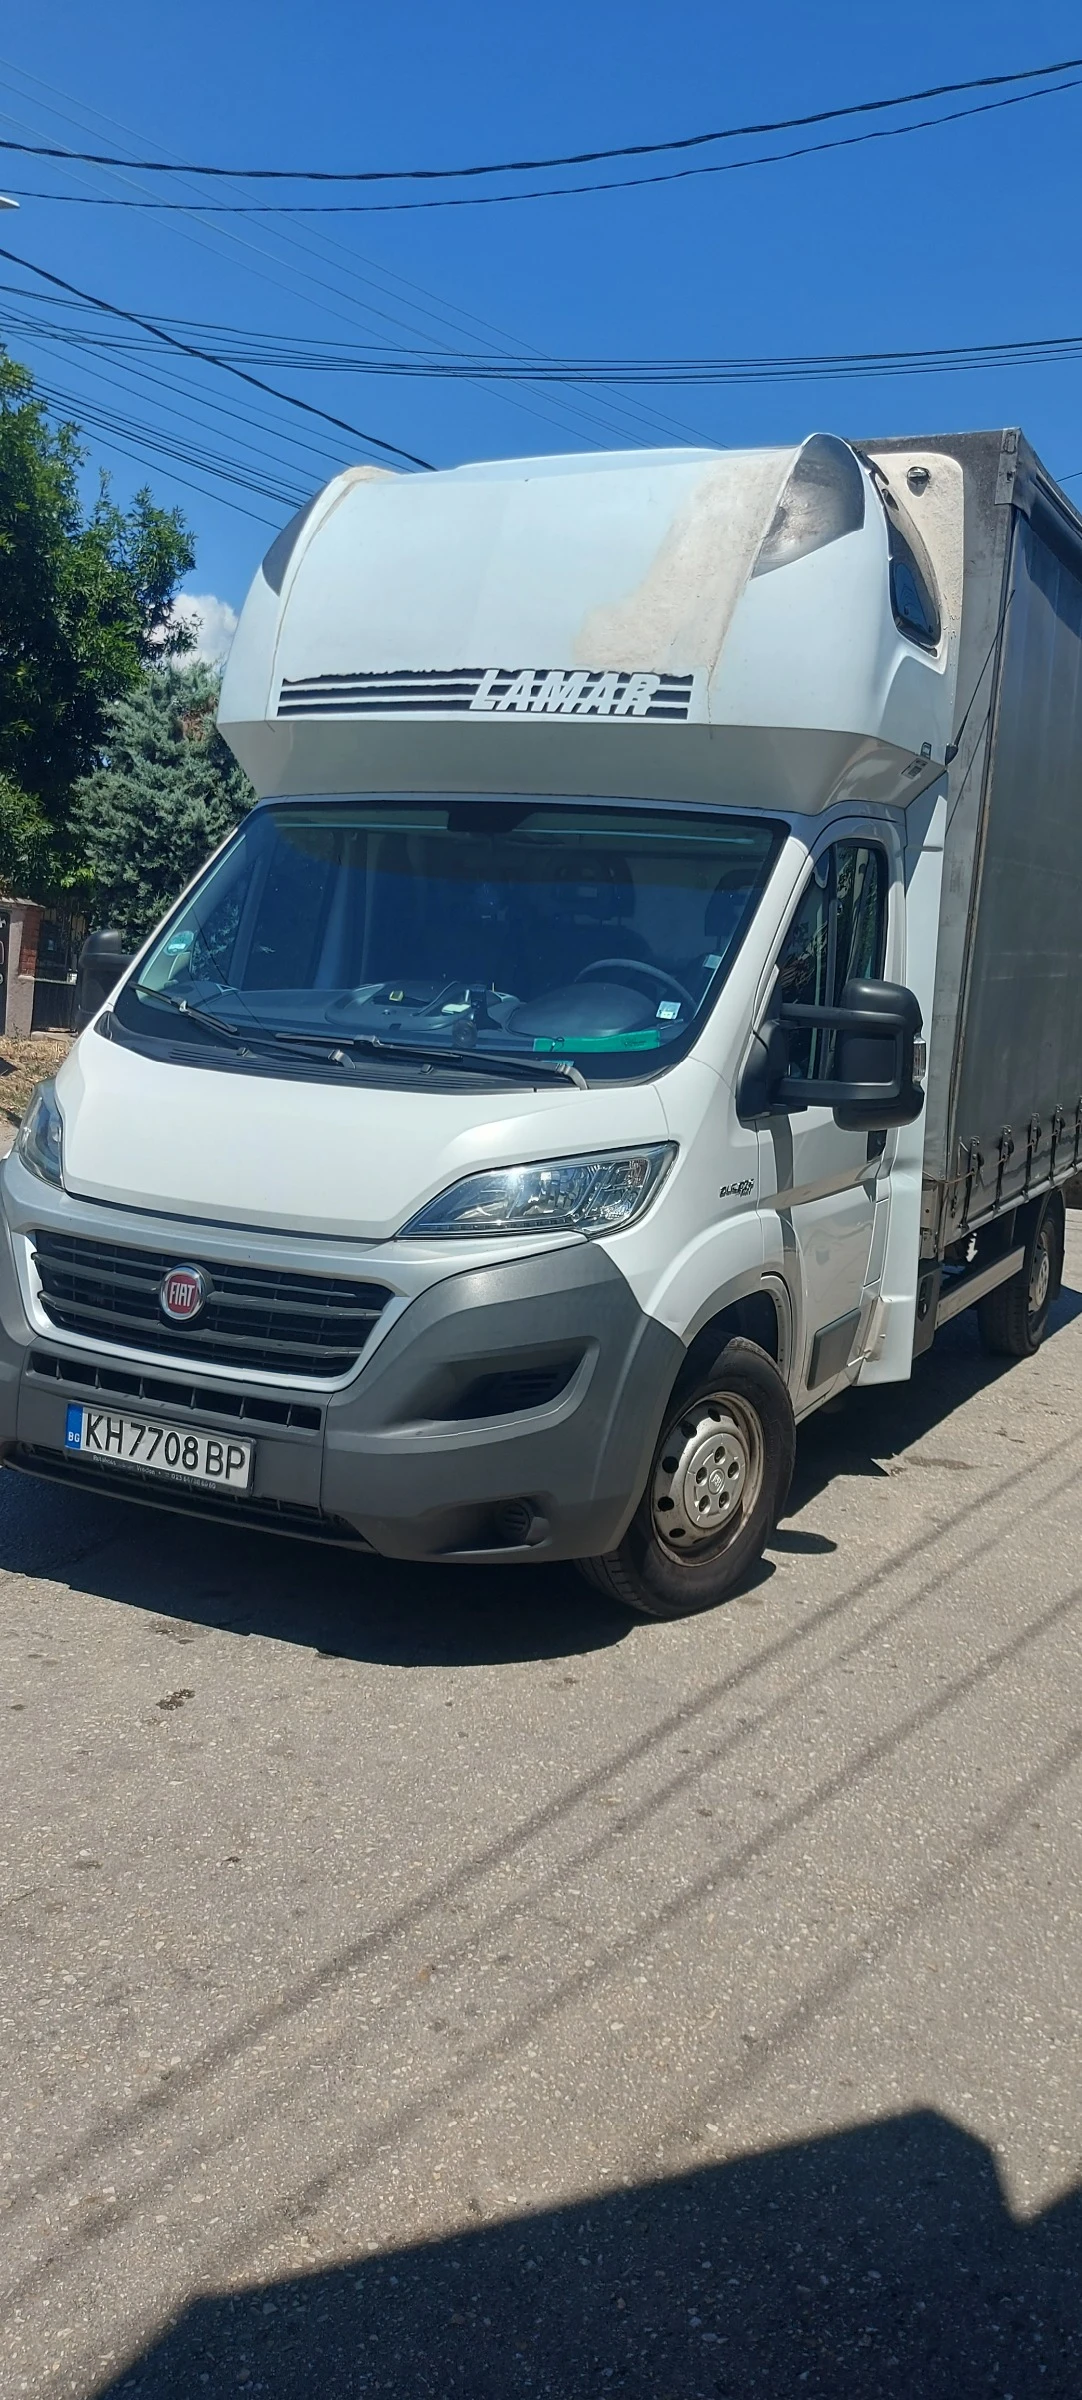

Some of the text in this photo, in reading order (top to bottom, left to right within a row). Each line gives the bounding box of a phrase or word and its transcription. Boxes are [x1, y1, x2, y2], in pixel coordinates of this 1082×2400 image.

[469, 668, 661, 716] LAMAR
[169, 1282, 195, 1307] FIAT
[67, 1431, 81, 1443] BG
